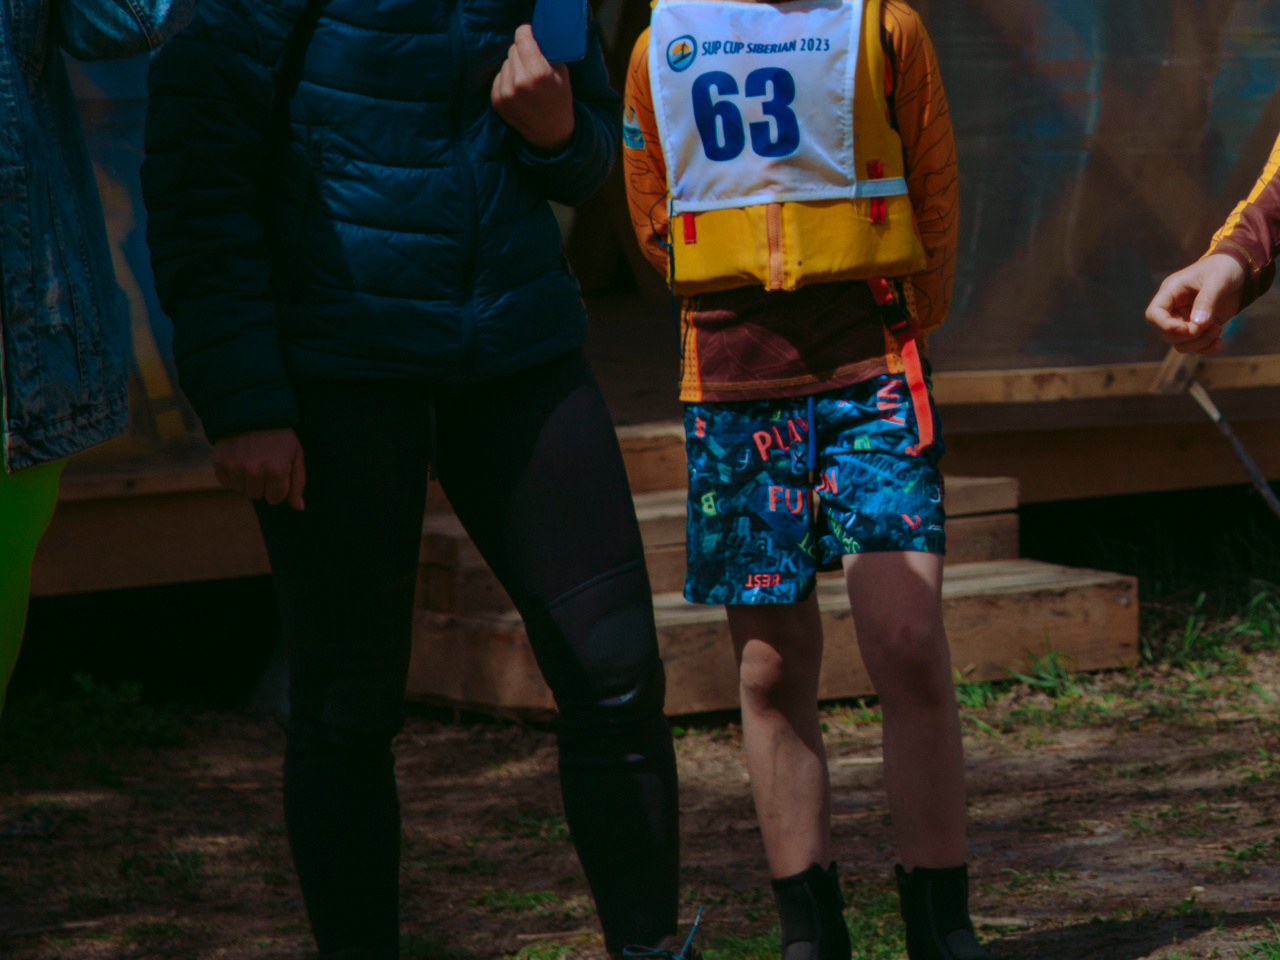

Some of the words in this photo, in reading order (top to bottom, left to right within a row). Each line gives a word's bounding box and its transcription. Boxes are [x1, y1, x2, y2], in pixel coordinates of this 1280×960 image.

[702, 40, 722, 56] SUP
[723, 40, 745, 54] CUP
[746, 39, 797, 54] SIBERIAN
[800, 37, 830, 52] 2023
[691, 66, 800, 162] 63
